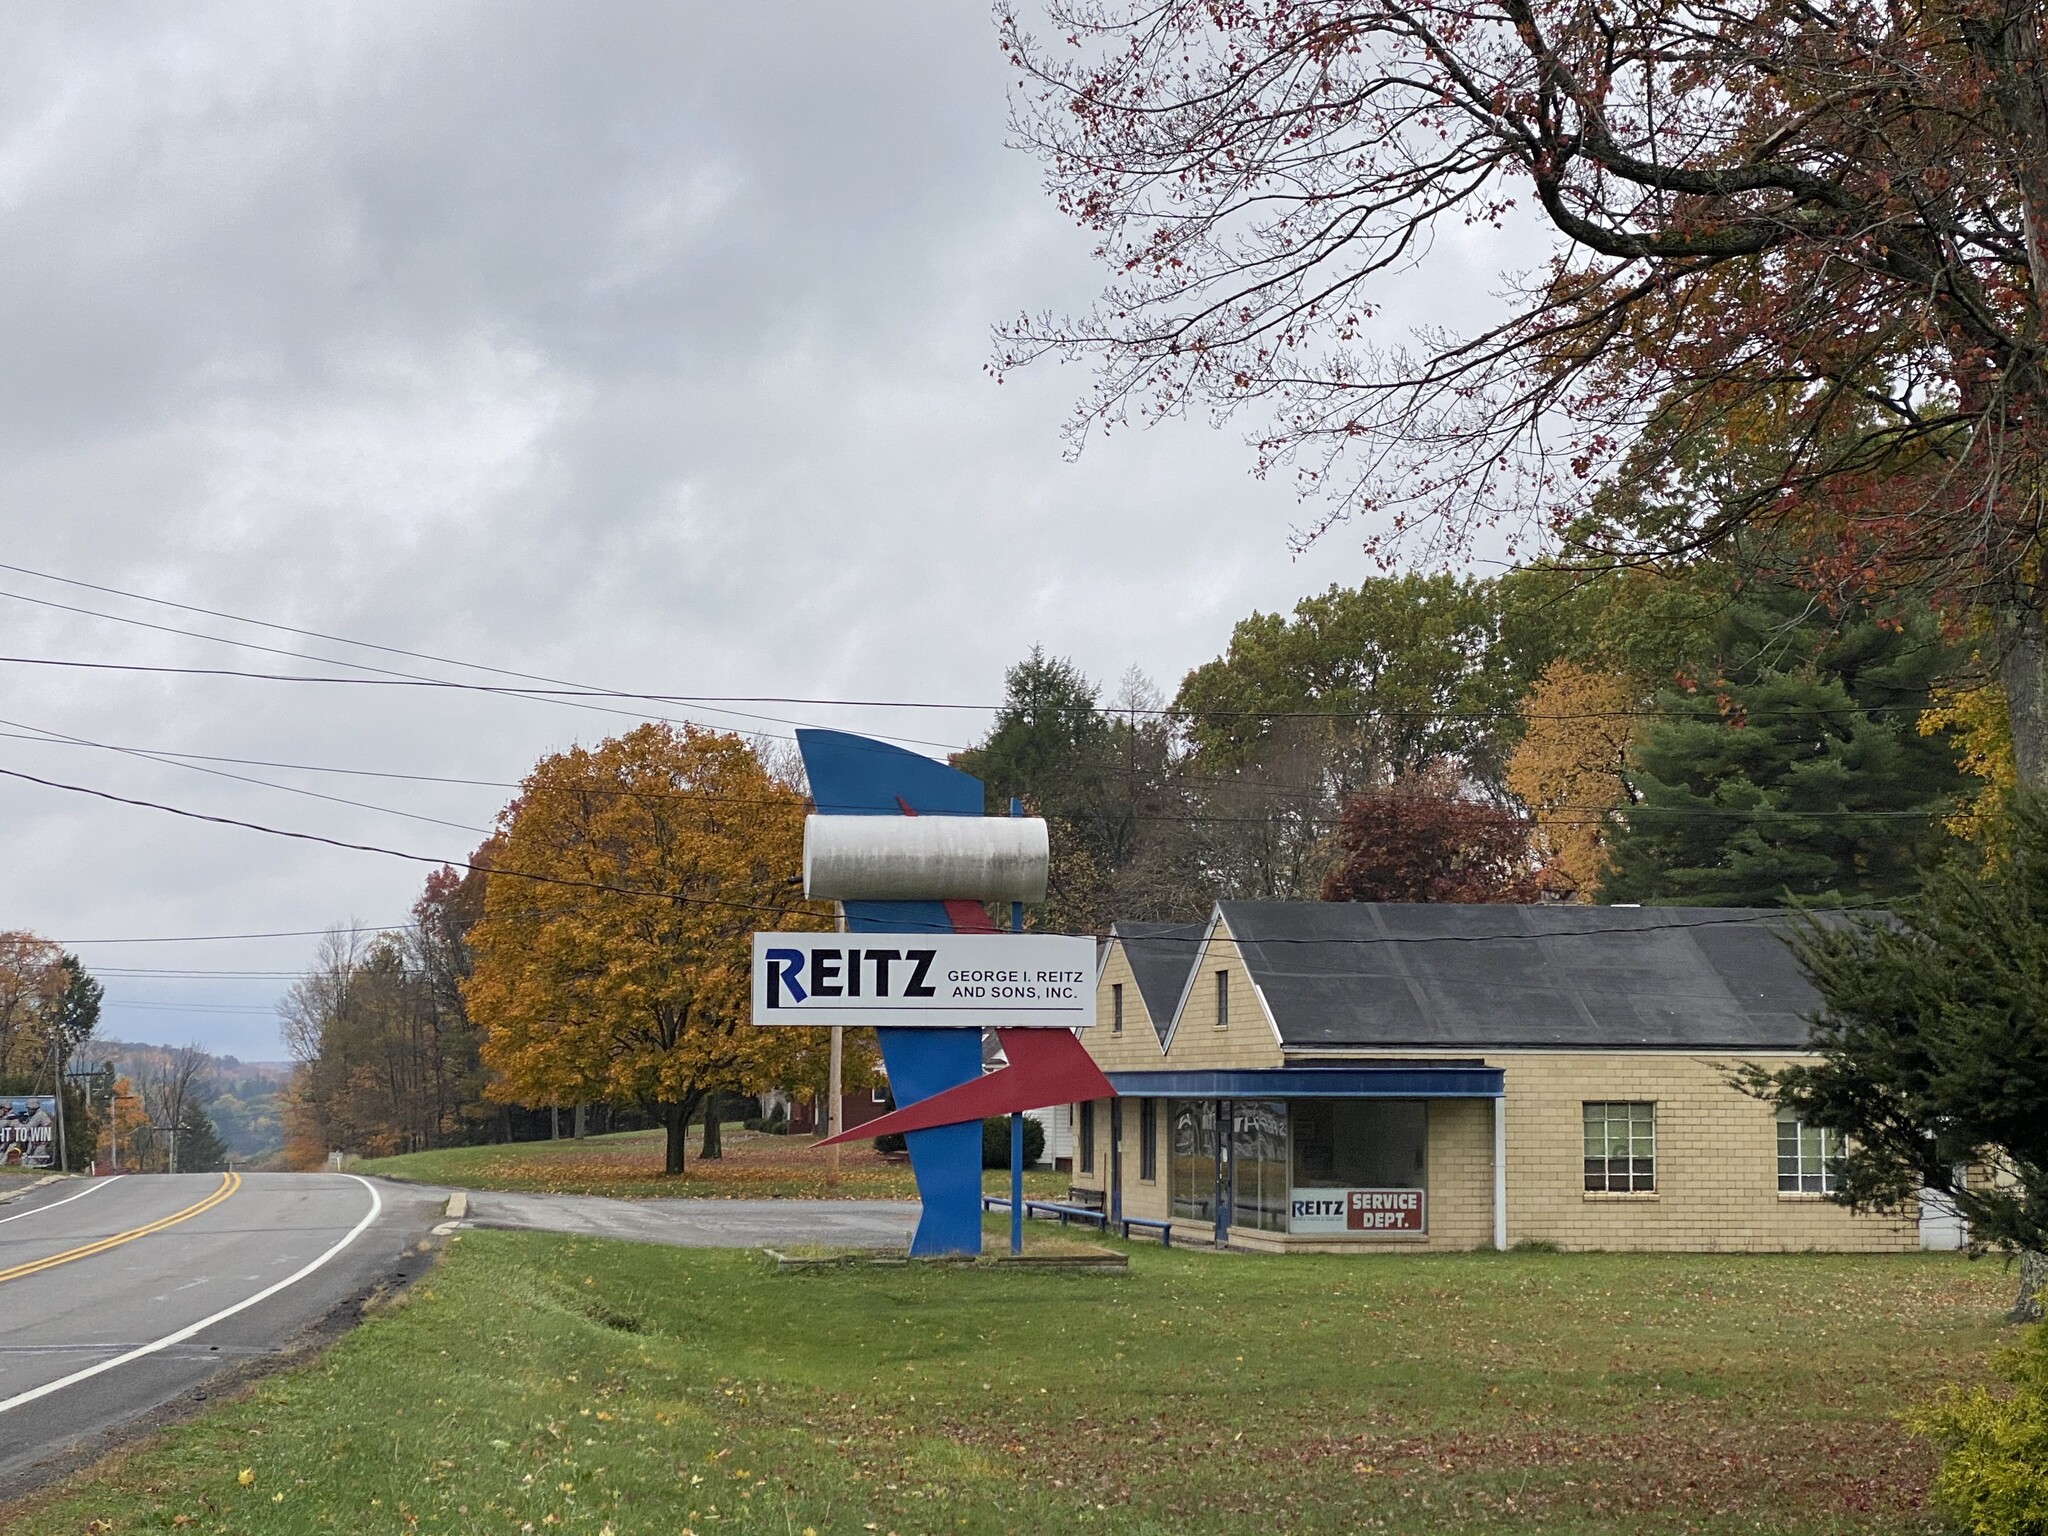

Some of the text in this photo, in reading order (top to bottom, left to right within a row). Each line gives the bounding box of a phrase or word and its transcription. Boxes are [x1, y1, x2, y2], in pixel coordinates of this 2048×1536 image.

[765, 949, 937, 1008] REITZ
[948, 970, 1084, 983] GEORGE I. REITZ
[952, 987, 1078, 1000] AND SONS, INC.
[14, 1127, 27, 1142] TO
[31, 1126, 51, 1142] WIN
[1292, 1200, 1343, 1217] REITZ
[1352, 1194, 1417, 1210] SERVICE
[1363, 1212, 1409, 1228] DEPT.
